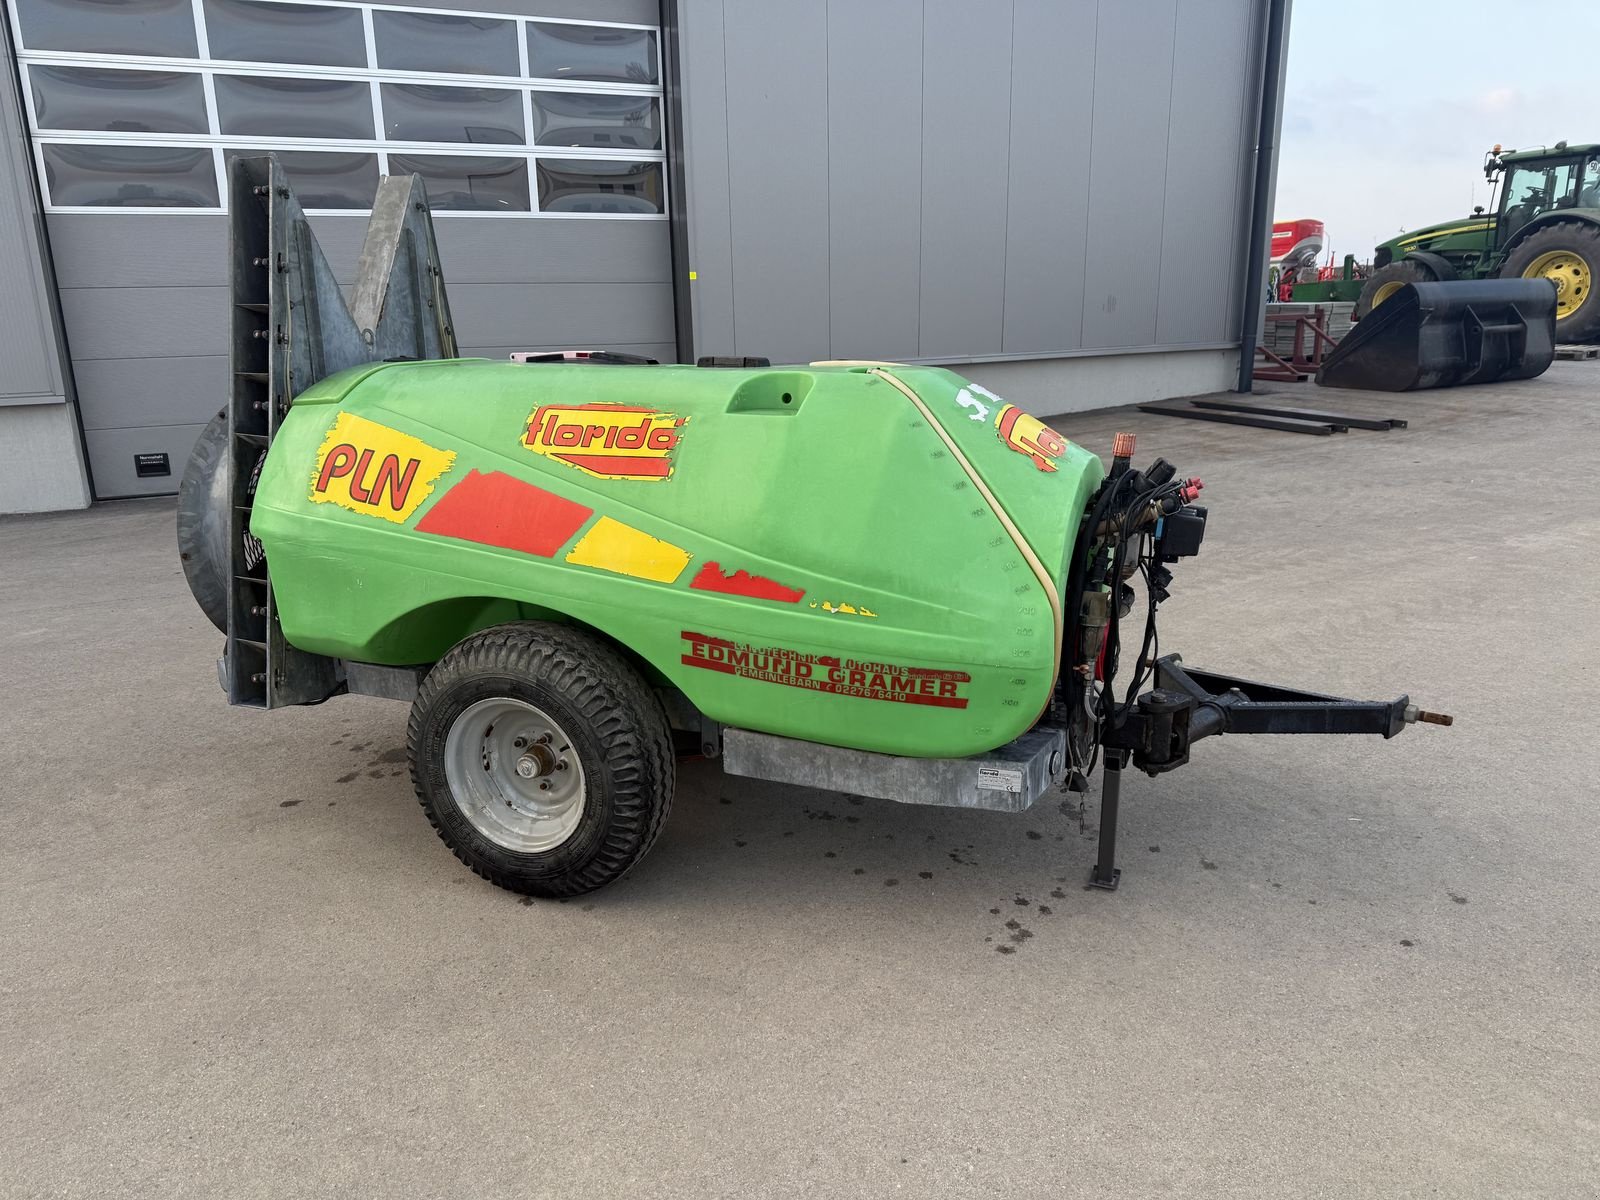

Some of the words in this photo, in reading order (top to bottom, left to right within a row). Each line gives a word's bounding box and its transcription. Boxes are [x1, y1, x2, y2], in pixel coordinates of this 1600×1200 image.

[524, 414, 675, 452] florida
[315, 442, 420, 512] PLN
[691, 641, 813, 678] EDMUND
[845, 657, 909, 678] UTOHAUS
[734, 666, 821, 690] GEMEINLEBARN
[835, 683, 907, 702] 02276/6410
